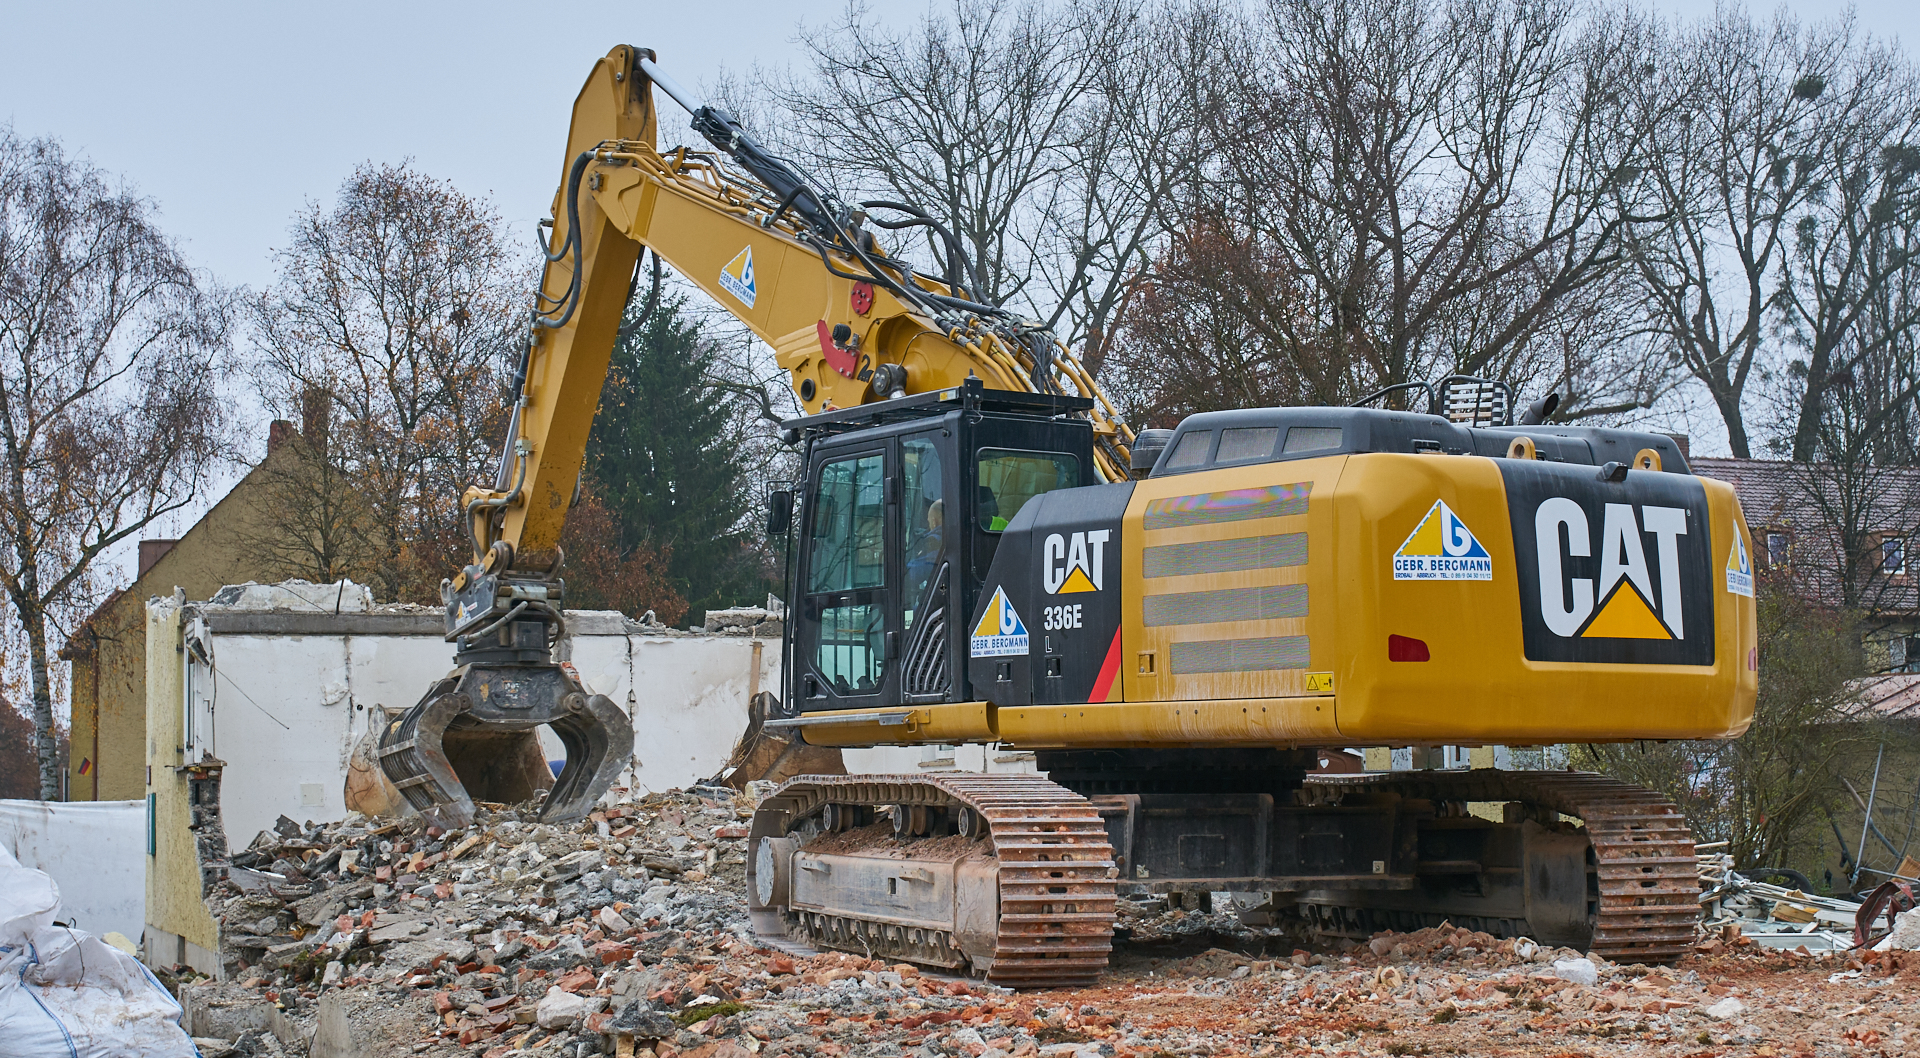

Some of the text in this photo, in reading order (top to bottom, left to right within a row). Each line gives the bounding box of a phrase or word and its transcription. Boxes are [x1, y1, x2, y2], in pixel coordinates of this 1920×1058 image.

[721, 271, 732, 286] GEBR.
[732, 281, 755, 303] BERGMANN
[1043, 529, 1110, 595] CAT
[1395, 559, 1491, 571] GEBR. BERGMANN
[1535, 497, 1687, 640] CAT
[1044, 604, 1082, 631] 336E
[972, 638, 1028, 649] GEBR. BERGMANN
[1045, 635, 1053, 653] L
